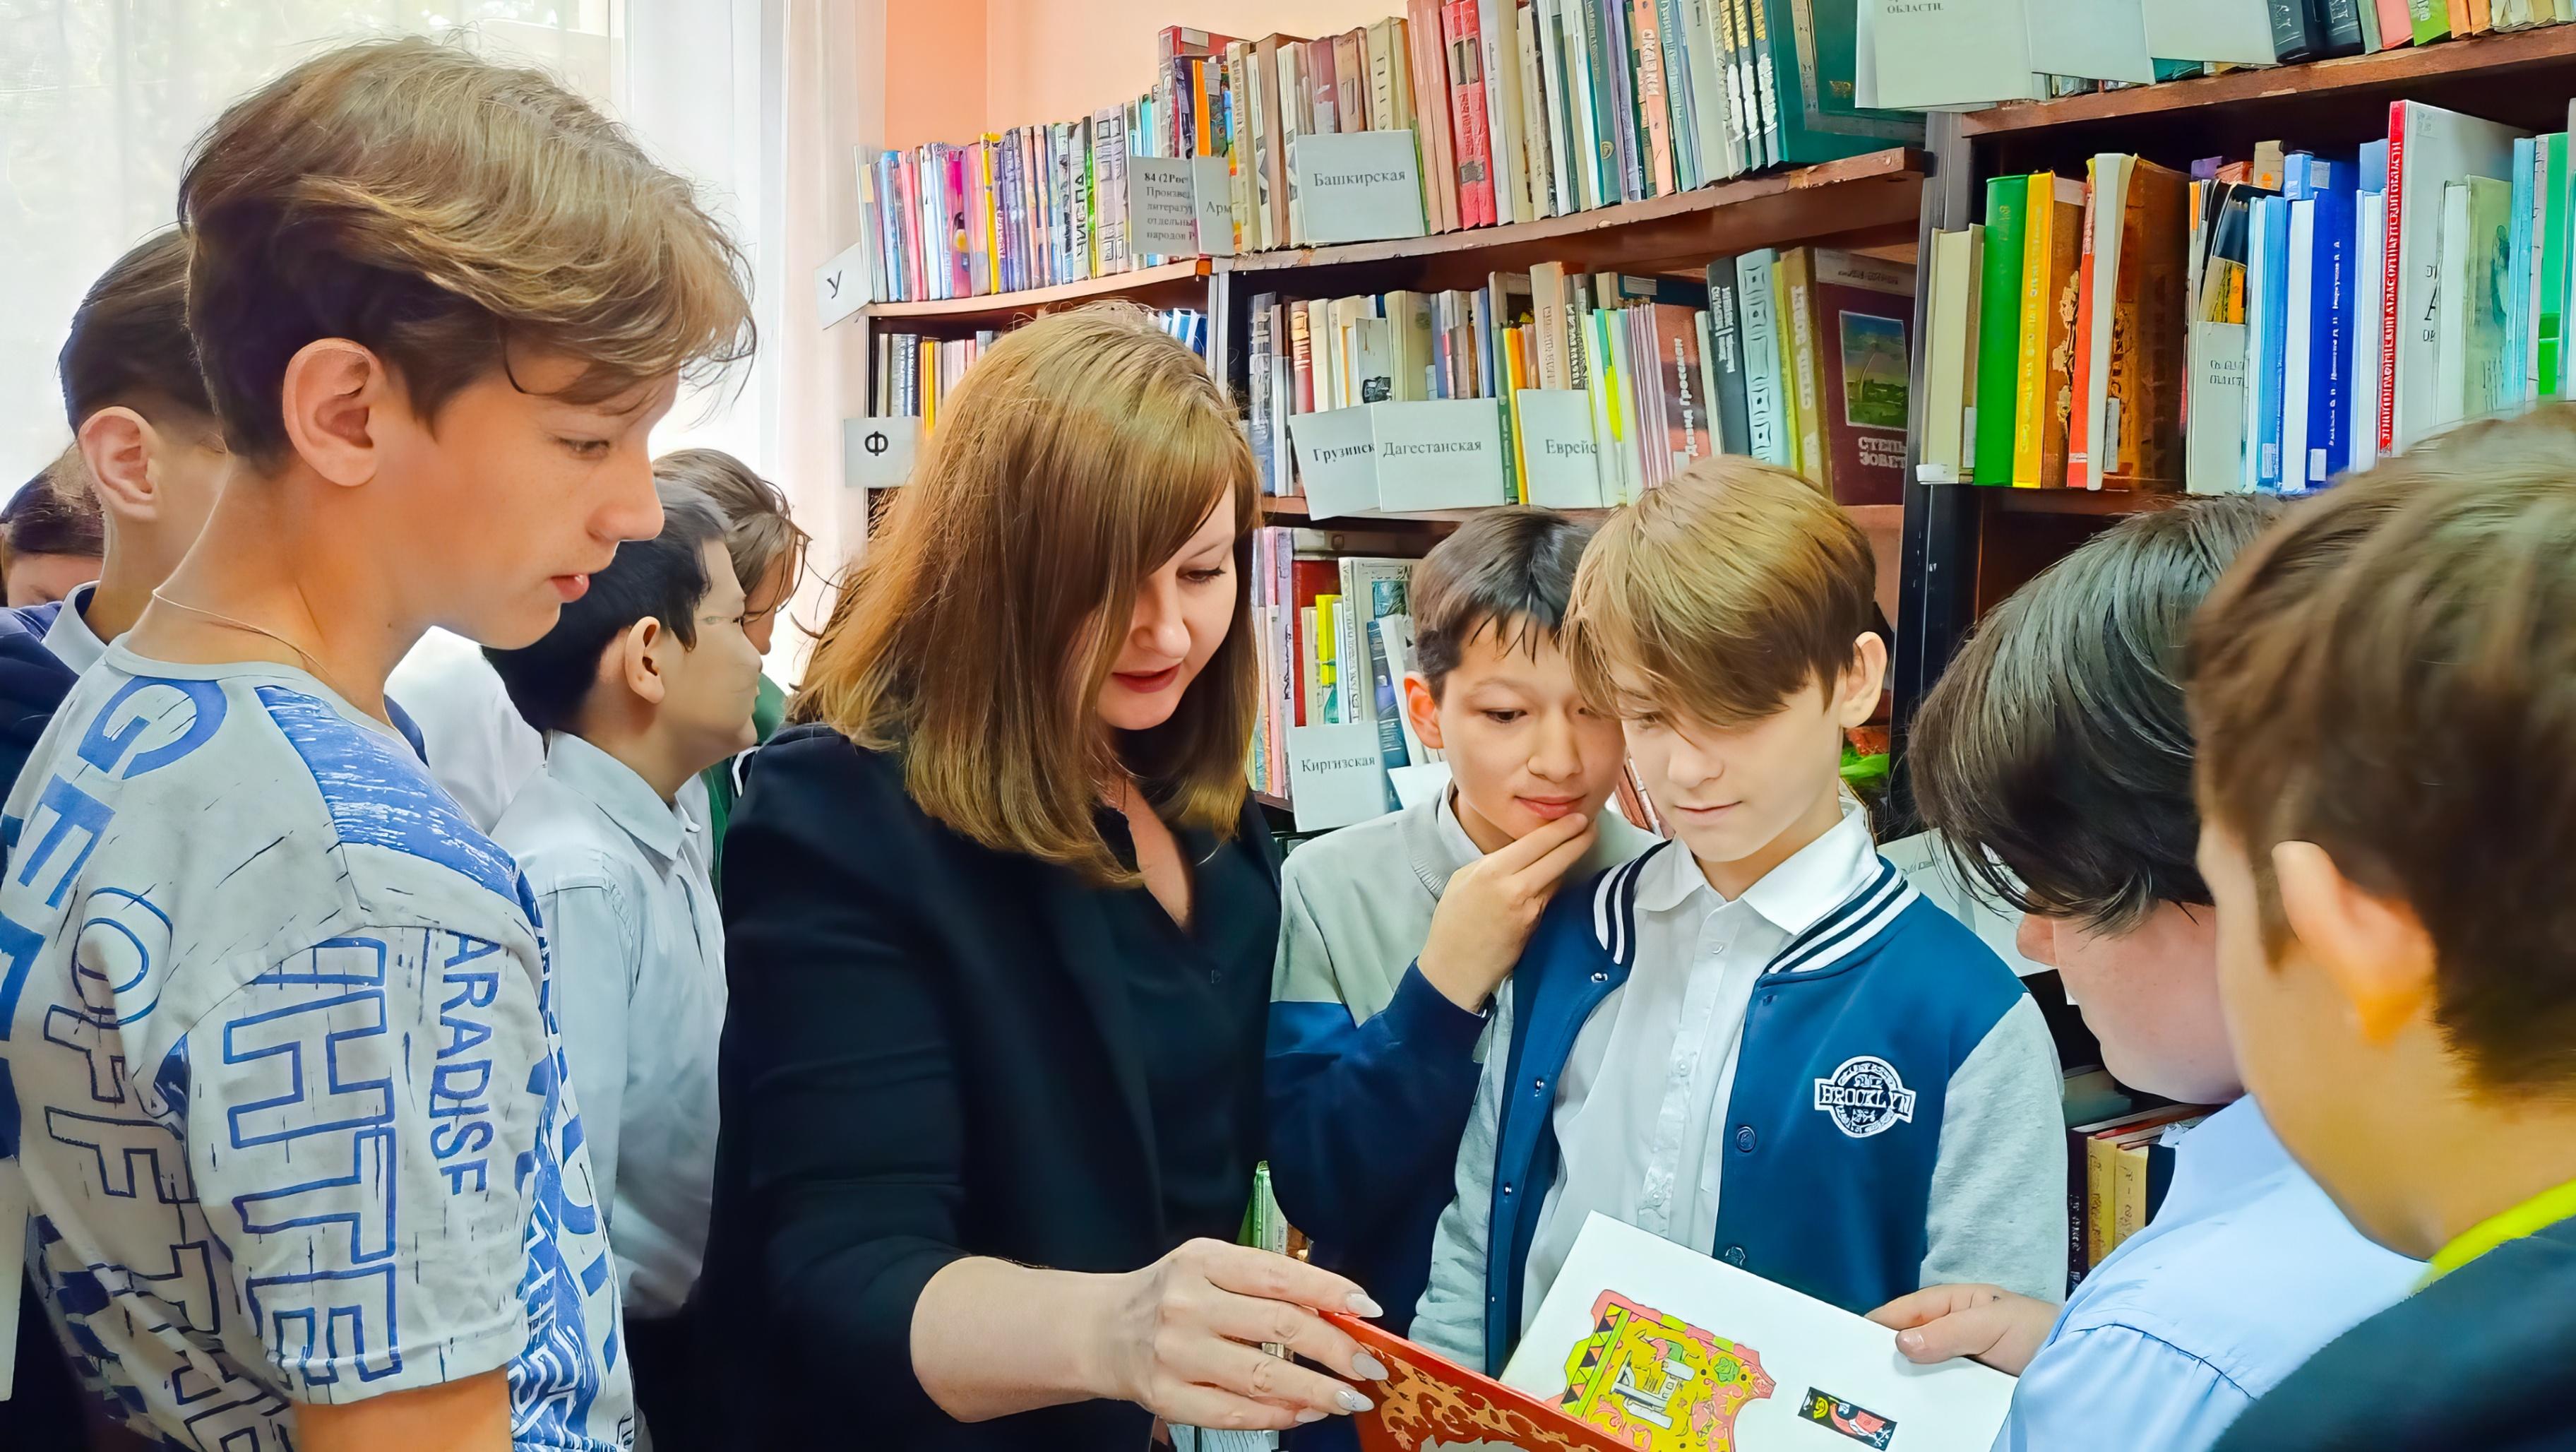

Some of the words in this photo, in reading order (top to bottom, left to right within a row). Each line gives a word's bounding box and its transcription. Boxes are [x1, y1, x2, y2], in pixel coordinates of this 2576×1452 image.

[1144, 172, 1156, 182] 84
[1313, 171, 1406, 187] Башкирская
[1674, 338, 1693, 406] Гроссман
[864, 430, 889, 457] Ф
[1383, 441, 1482, 458] Дагестанская
[1301, 756, 1376, 775] Киргизская
[1820, 1085, 1912, 1114] BROOKLYN
